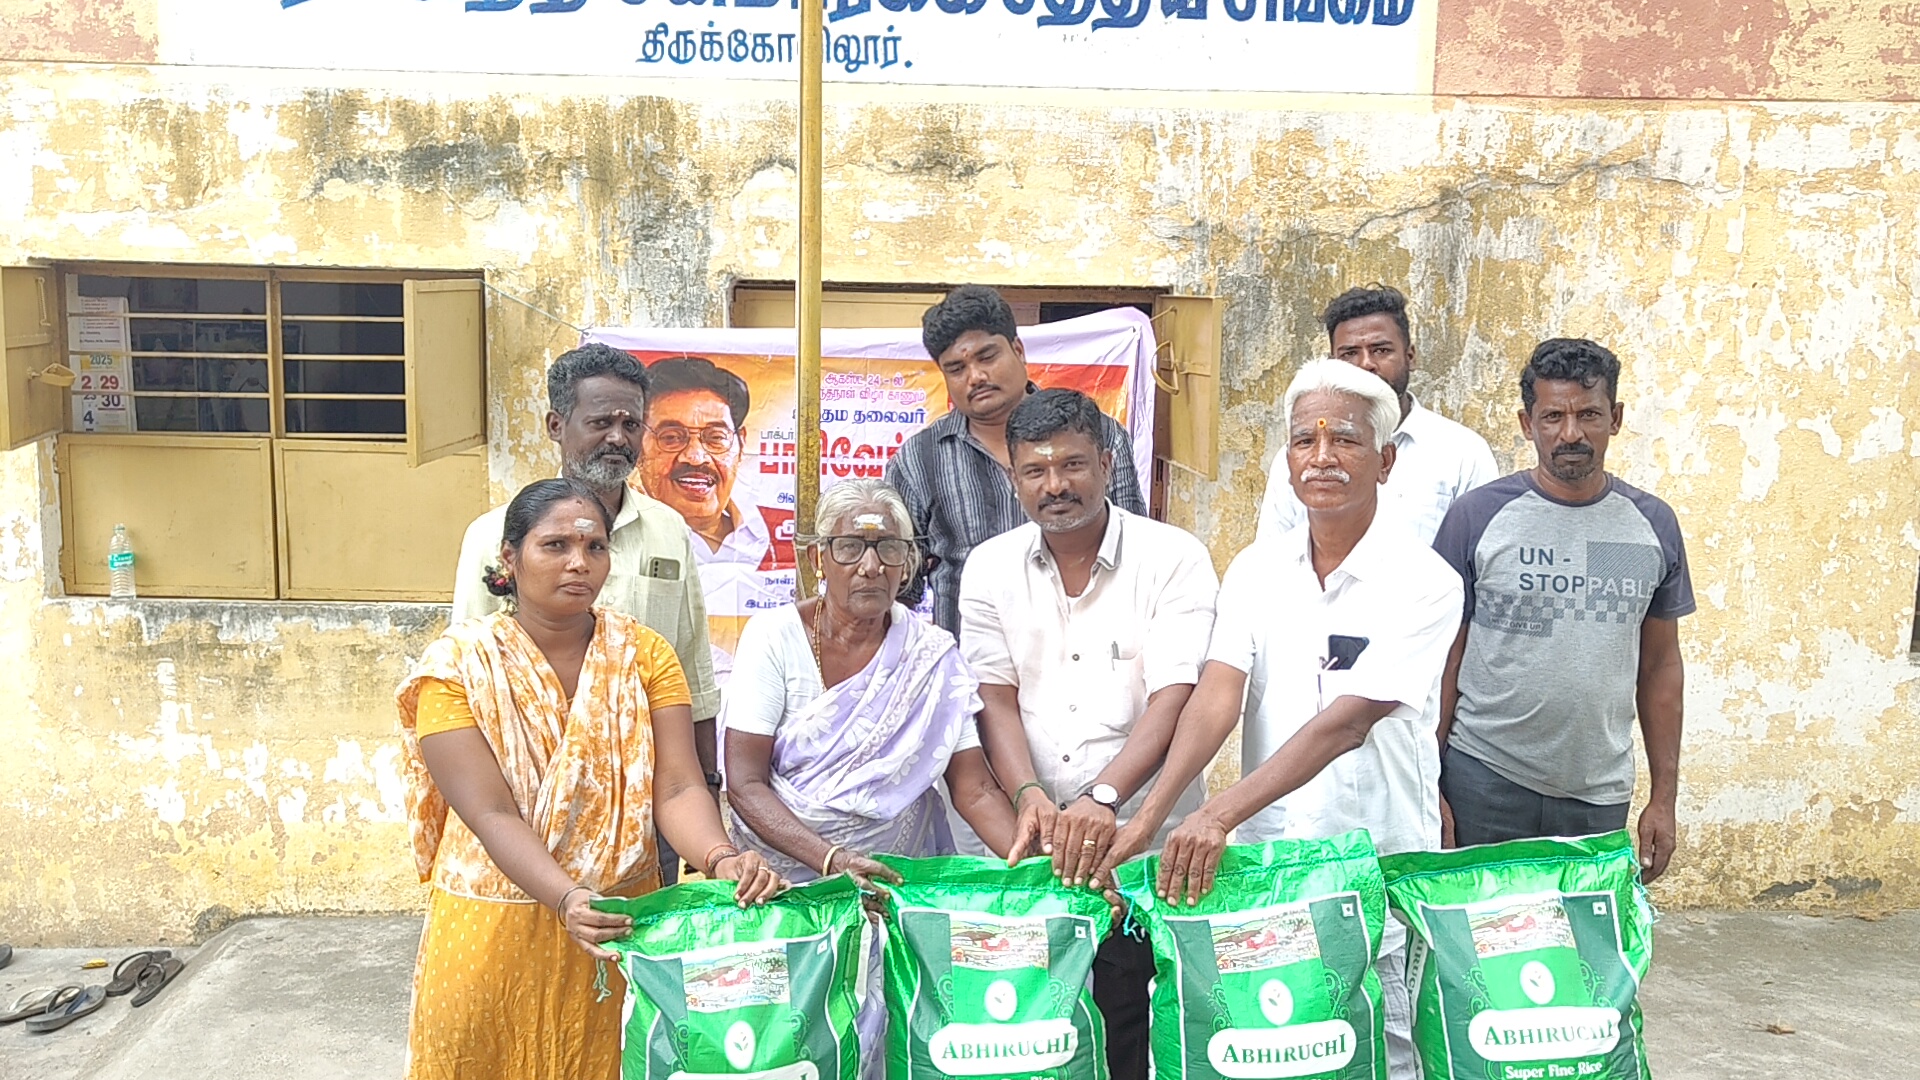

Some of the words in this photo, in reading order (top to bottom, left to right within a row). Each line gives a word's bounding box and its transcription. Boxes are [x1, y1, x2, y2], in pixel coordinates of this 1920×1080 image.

[635, 21, 913, 73] திருக்கோிலூர்.
[90, 354, 113, 365] 2025
[100, 375, 119, 390] 29
[868, 375, 880, 386] 24
[101, 394, 121, 407] 30
[852, 408, 926, 425] தலைவர்
[1519, 546, 1554, 566] UN
[1519, 572, 1656, 599] STOPPABLE
[941, 1032, 1072, 1059] ABHIRUCHI
[1221, 1033, 1347, 1063] ABHIRUCHI
[1504, 1066, 1545, 1080] Super
[1548, 1063, 1575, 1077] Fine
[1577, 1061, 1603, 1075] Rice
